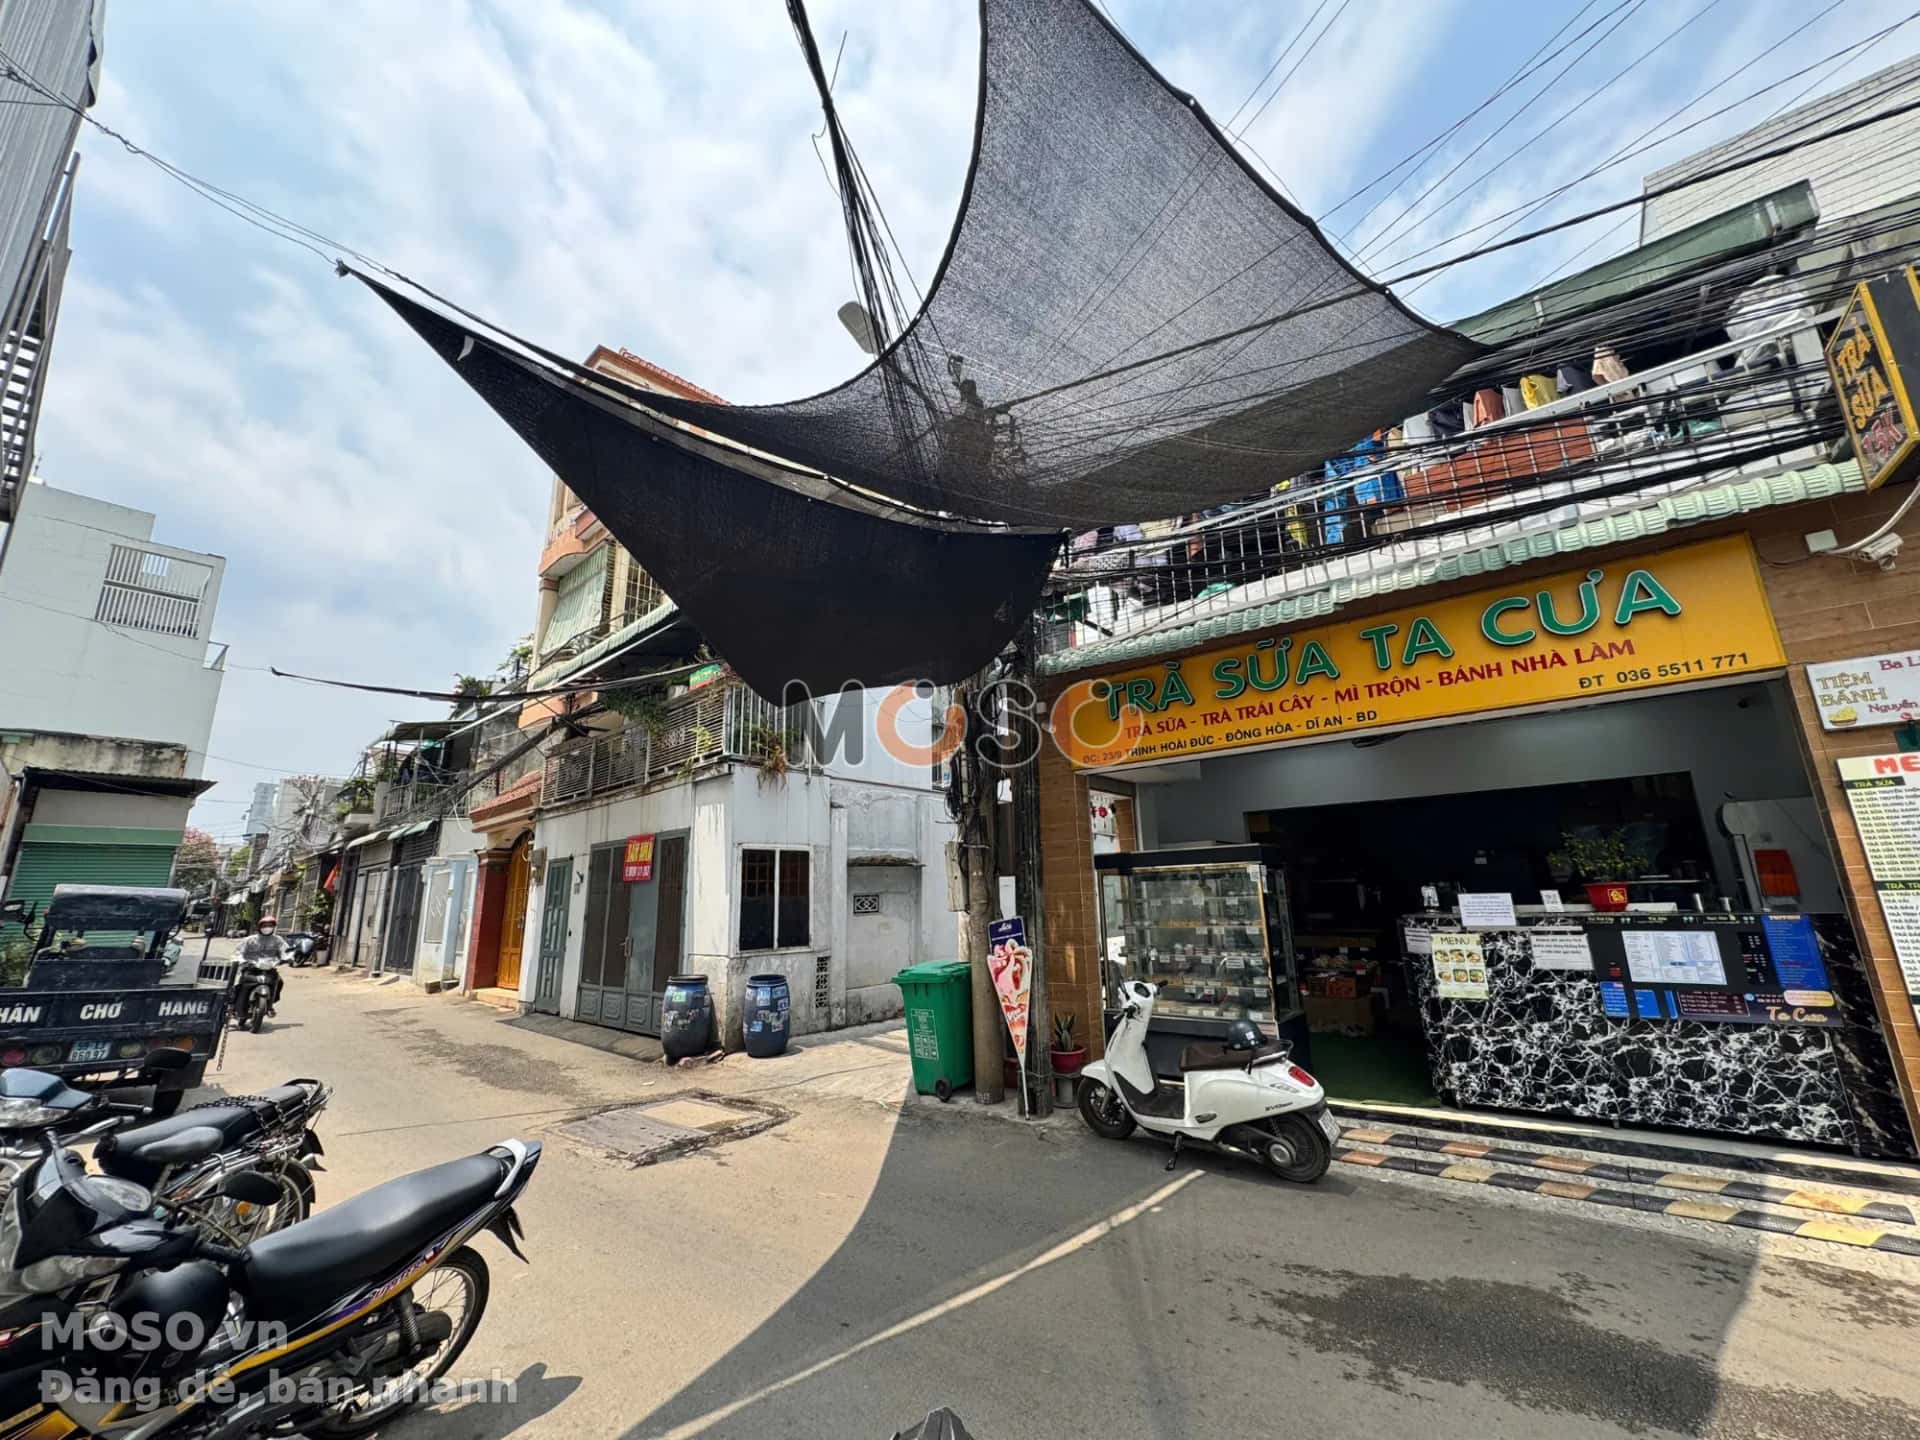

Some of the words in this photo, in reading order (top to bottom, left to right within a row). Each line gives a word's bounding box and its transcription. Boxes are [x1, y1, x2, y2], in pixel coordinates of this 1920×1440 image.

[1103, 663, 1196, 721] TRÀ
[1211, 640, 1342, 701] SỮA
[1362, 617, 1456, 671] TA
[1480, 567, 1683, 648] CƯA
[1579, 673, 1605, 690] ĐT
[1616, 668, 1653, 685] 036
[1657, 659, 1706, 679] 5511
[1712, 651, 1750, 671] 771
[1879, 659, 1904, 672] Ba
[1200, 709, 1233, 727] TRÀ
[1235, 701, 1275, 721] TRÁI
[1279, 694, 1316, 713] CÂY
[1361, 675, 1422, 699] TRỘN
[1437, 660, 1505, 689] BÁNH
[1509, 648, 1569, 678] NHÀ
[1575, 638, 1637, 666] LÀM
[1819, 687, 1889, 708] BÁNH
[1323, 714, 1343, 727] AN
[1356, 710, 1378, 722] BD
[1439, 937, 1470, 945] MENU
